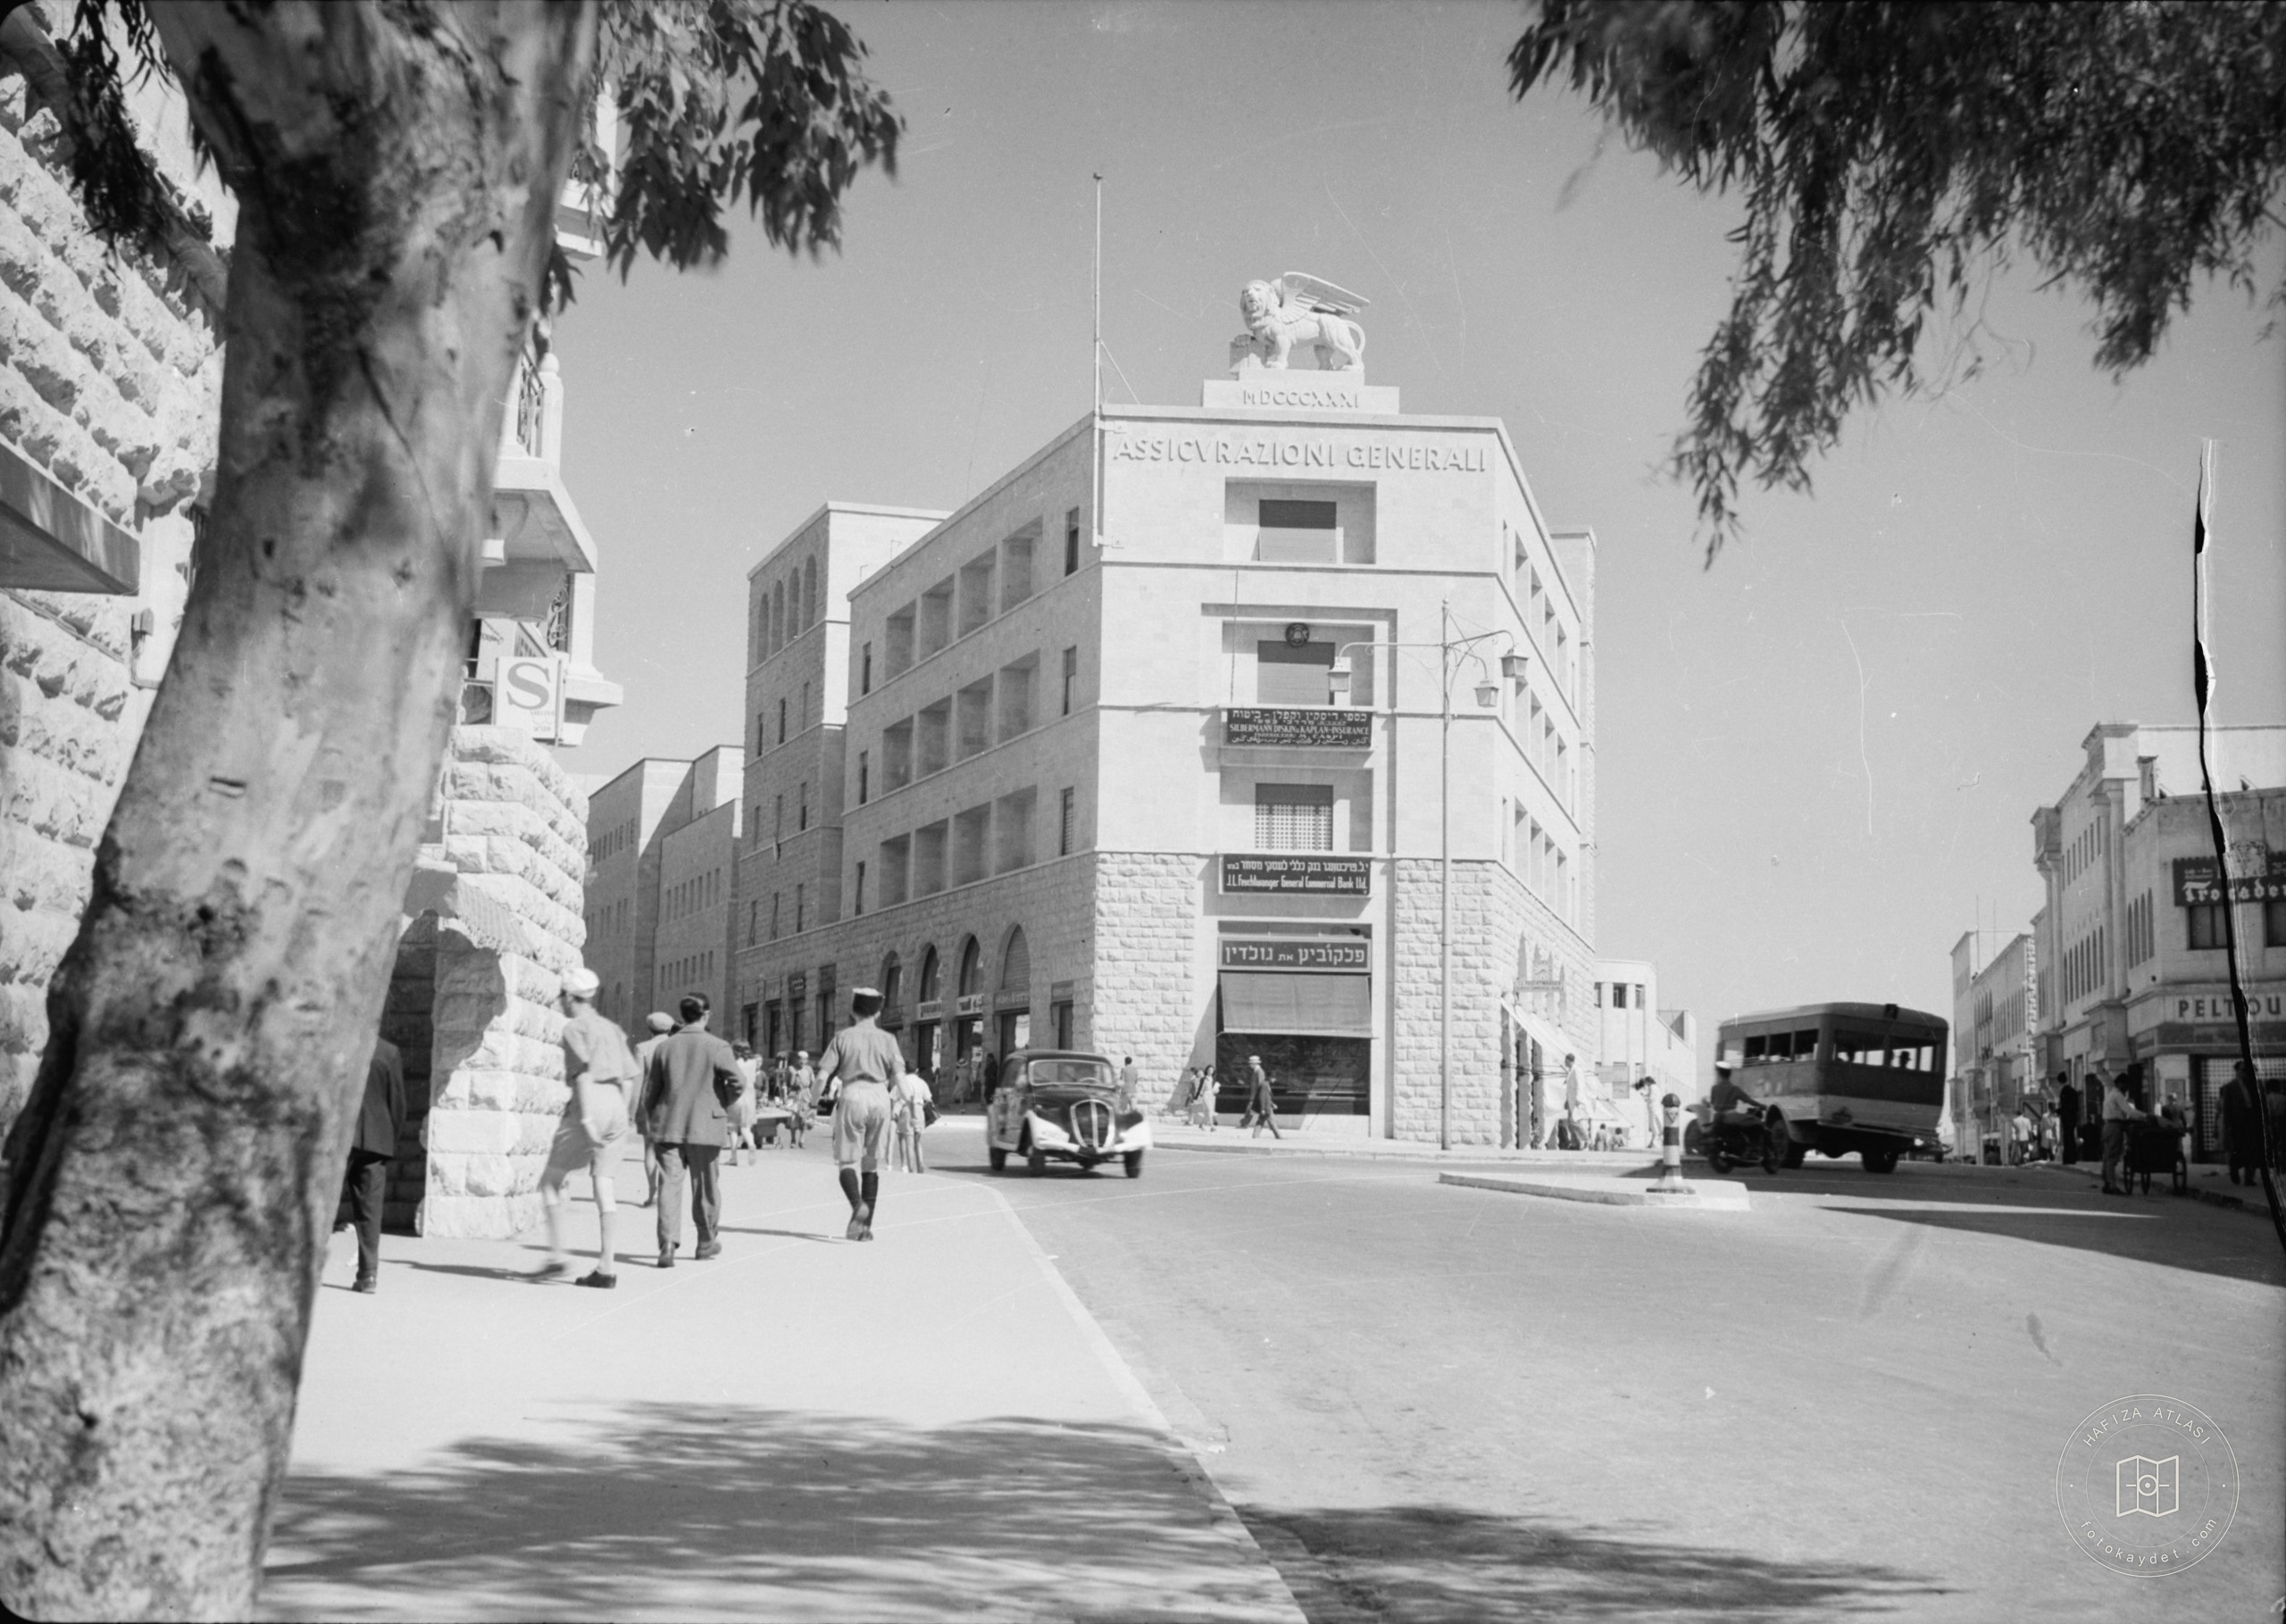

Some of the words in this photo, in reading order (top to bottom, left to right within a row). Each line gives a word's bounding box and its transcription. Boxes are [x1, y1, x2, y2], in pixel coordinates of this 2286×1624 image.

[1242, 389, 1359, 409] MDCCCXXXI
[1113, 438, 1336, 467] ASSICVRAZIONI
[1347, 446, 1487, 472] GENERALI
[506, 662, 550, 710] S
[1232, 710, 1262, 720] ביטוח
[1240, 860, 1263, 870] מסחר
[1264, 859, 1288, 872] לעסקי
[1289, 859, 1306, 871] כללי
[1307, 862, 1321, 874] בנק
[1281, 875, 1305, 888] General
[1305, 875, 1336, 889] Commercial
[1337, 876, 1355, 889] Bank
[1224, 945, 1273, 964] גולדין
[1278, 953, 1294, 962] את
